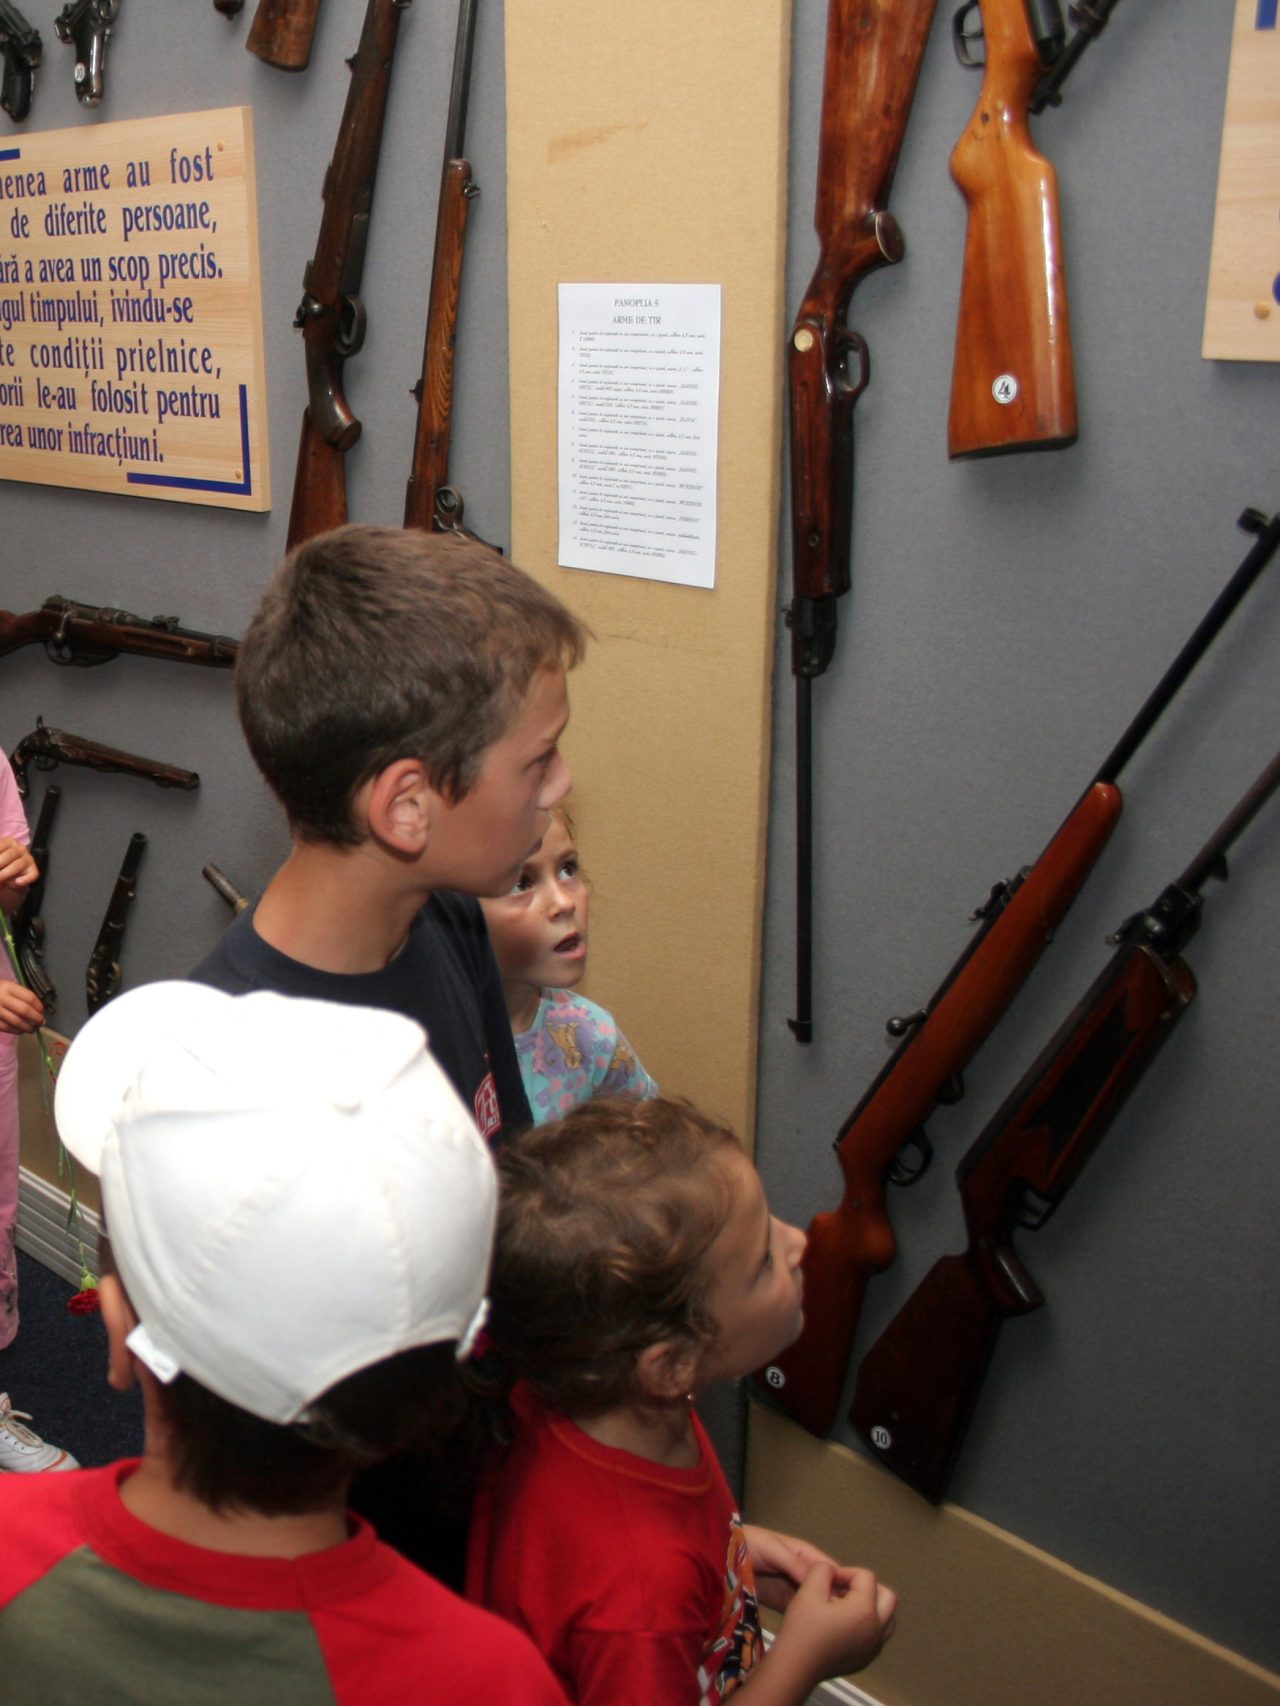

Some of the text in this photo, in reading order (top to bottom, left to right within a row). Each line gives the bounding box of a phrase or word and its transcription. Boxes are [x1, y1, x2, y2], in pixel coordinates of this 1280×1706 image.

[64, 164, 110, 192] arme
[128, 161, 150, 187] au
[170, 146, 213, 183] fost
[11, 208, 29, 238] de
[45, 203, 106, 236] diferite
[122, 202, 216, 240] persoane,
[25, 260, 34, 283] a
[39, 258, 75, 282] avea
[81, 258, 102, 281] un
[109, 256, 150, 291] scop
[159, 243, 222, 288] precis.
[30, 291, 104, 331] timpului,
[112, 289, 193, 323] ivindu-se
[612, 315, 662, 325] ARME DE TIR
[614, 298, 652, 308] PANOPLIA
[31, 337, 104, 378] condiții
[116, 339, 220, 380] prielnice,
[37, 378, 76, 410] le-au
[92, 380, 148, 414] folosit
[157, 385, 220, 423] pentru
[998, 380, 1010, 397] 4
[28, 425, 63, 450] unor
[69, 423, 163, 466] infracțiuni.
[771, 1371, 780, 1384] 8
[875, 1430, 887, 1445] 10
